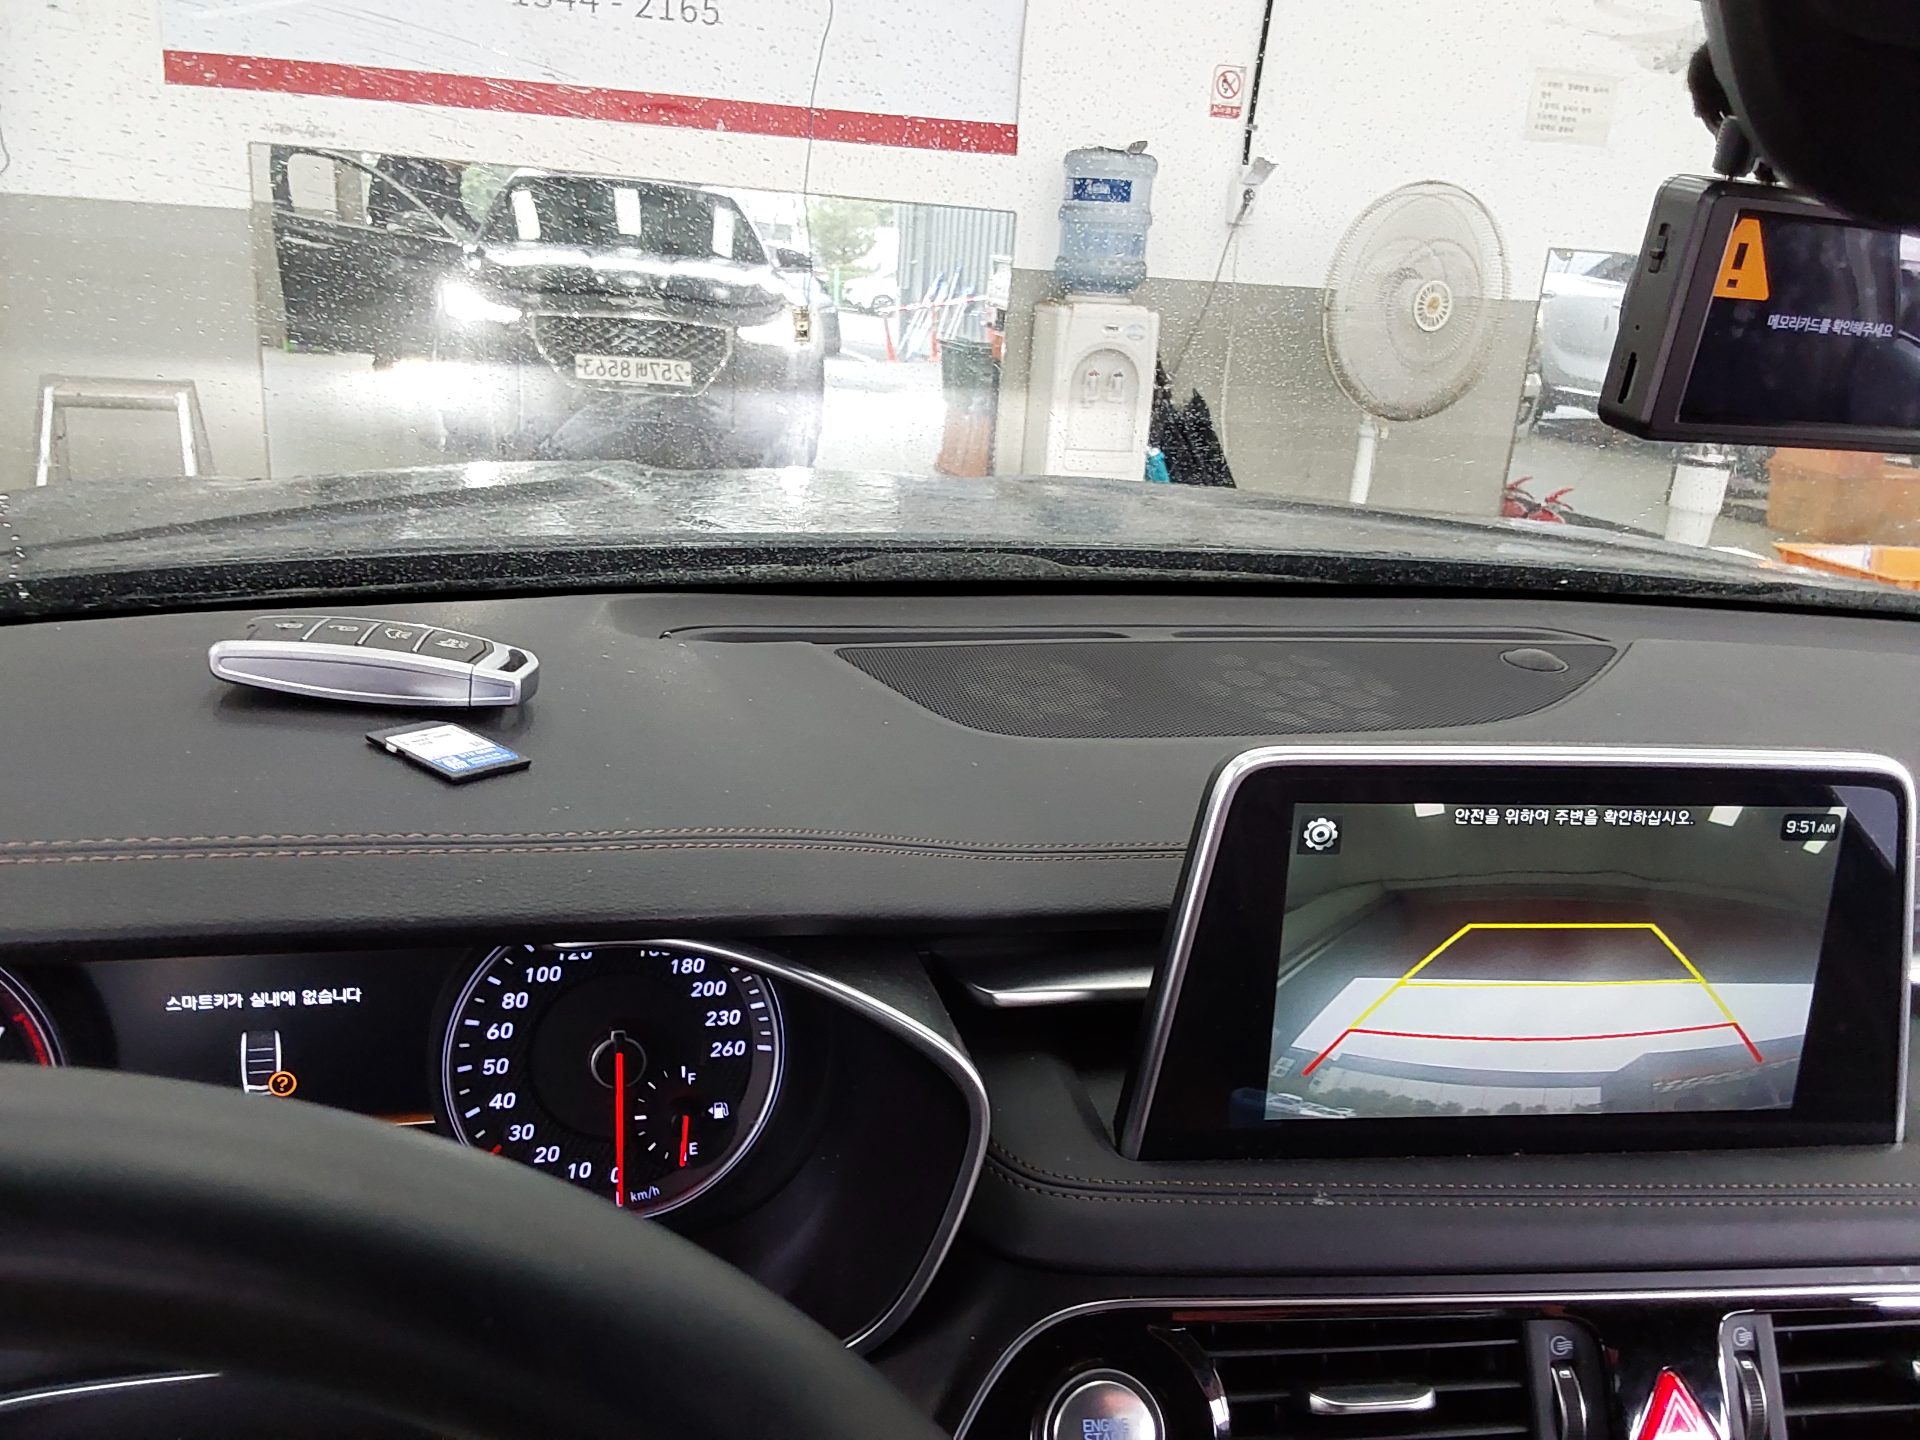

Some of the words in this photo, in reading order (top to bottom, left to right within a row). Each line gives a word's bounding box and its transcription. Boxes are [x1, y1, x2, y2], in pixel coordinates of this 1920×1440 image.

[1767, 314, 1831, 334] 메모리카드를
[1832, 318, 1894, 338] 확인해주세요
[1454, 808, 1500, 825] 안전을
[1504, 808, 1550, 825] 위하여
[1554, 809, 1599, 826] 주변을
[1603, 809, 1694, 826] 확인하십시오.
[525, 965, 562, 983] 100
[671, 957, 706, 975] 180
[690, 980, 727, 998] 200
[165, 993, 244, 1012] 스마트키가
[249, 990, 296, 1008] 실내에
[301, 987, 363, 1006] 없습니다
[501, 991, 529, 1010] 80
[704, 1009, 742, 1027] 230
[486, 1022, 514, 1040] 60
[709, 1040, 746, 1058] 260
[482, 1057, 510, 1076] 50
[687, 1072, 697, 1085] F
[488, 1091, 517, 1110] 40
[508, 1123, 535, 1142] 30
[533, 1145, 561, 1164] 20
[688, 1141, 699, 1156] E
[568, 1161, 592, 1180] 10
[629, 1185, 661, 1202] km/h
[1082, 1418, 1129, 1433] ENGE
